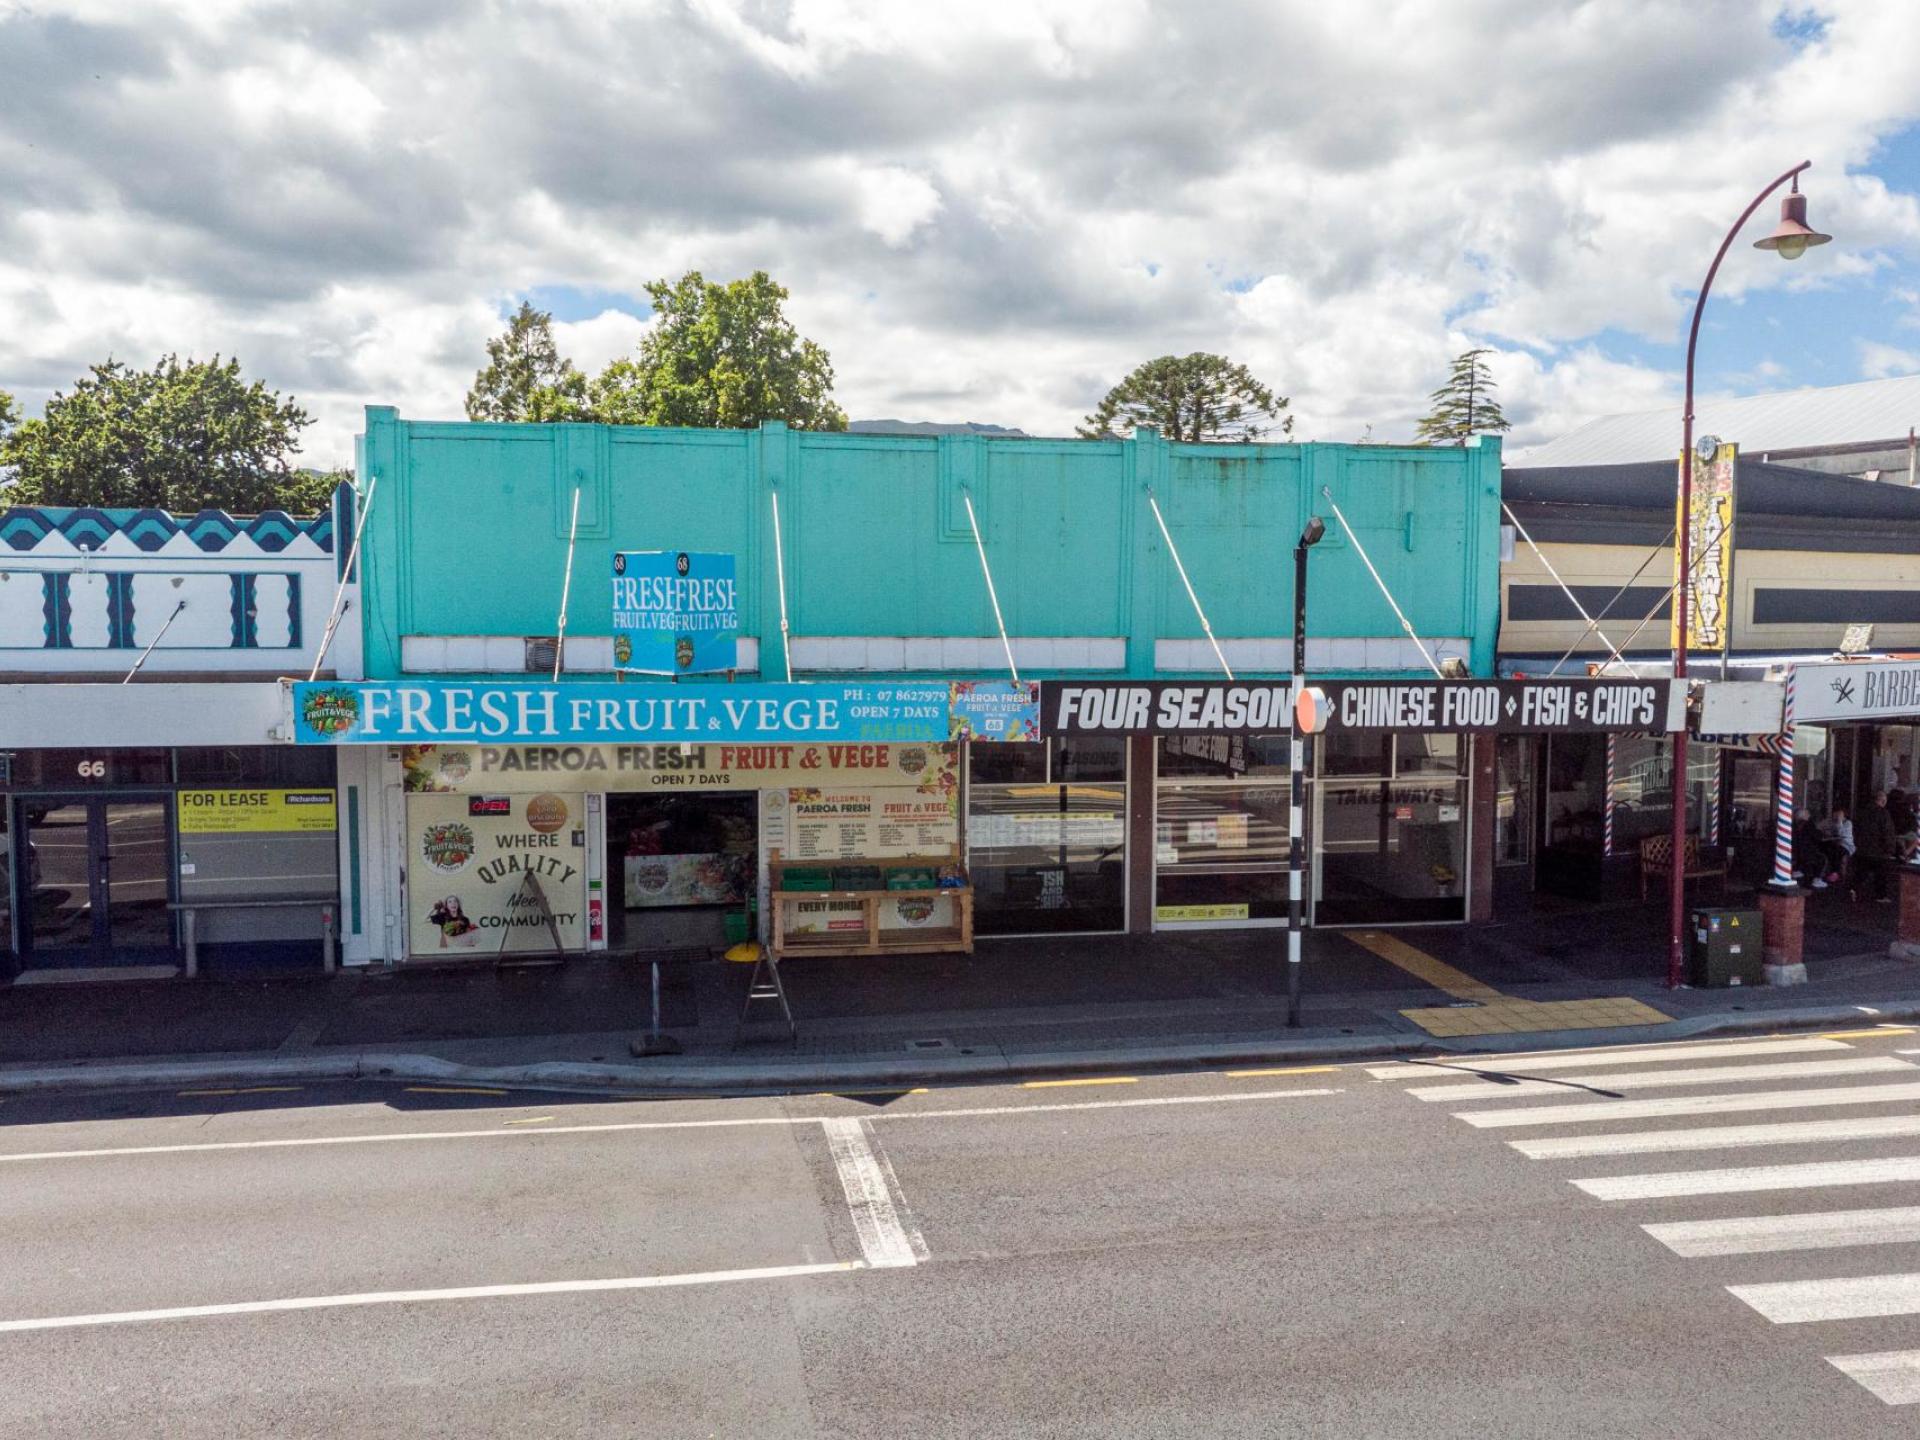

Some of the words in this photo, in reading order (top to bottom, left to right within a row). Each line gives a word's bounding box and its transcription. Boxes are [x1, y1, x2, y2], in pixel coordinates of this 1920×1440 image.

[615, 557, 625, 570] 68
[677, 557, 688, 570] 68
[877, 690, 892, 701] 07
[896, 690, 946, 702] 8627979
[957, 693, 998, 702] PAEROA
[1001, 693, 1031, 702] FRESH
[359, 688, 559, 736] FRESH
[569, 699, 705, 731] FRUIT
[708, 716, 721, 730] &
[721, 699, 840, 730] VEGE
[850, 706, 889, 718] OPEN
[893, 708, 900, 718] 7
[904, 706, 939, 718] DAYS
[967, 703, 988, 712] FRUIT
[1001, 703, 1022, 712] VEGE
[1057, 688, 1151, 729] FOUR
[1157, 688, 1292, 729] SEASON
[1341, 686, 1437, 727] CHINESE
[1442, 686, 1500, 727] FOOD
[1521, 686, 1571, 726] FISH
[1575, 691, 1588, 719] &
[1592, 686, 1656, 726] CHIPS
[481, 747, 607, 772] PAEROA
[617, 745, 706, 770] FRESH
[720, 746, 794, 770] FRUIT
[800, 746, 821, 769] &
[827, 745, 889, 768] VEGE
[77, 761, 105, 777] 66
[651, 775, 684, 785] OPEN
[688, 774, 695, 784] 7
[699, 774, 730, 784] DAYS
[183, 794, 215, 806] FOR
[220, 793, 268, 806] LEASE
[797, 804, 838, 813] PAEROA
[841, 803, 871, 812] FRESH
[885, 804, 912, 813] FRUIT
[925, 803, 947, 811] VEGE
[496, 834, 559, 848] WHERE
[477, 854, 576, 884] QUALITY
[506, 893, 547, 908] Mee
[798, 902, 827, 912] EVERY
[828, 900, 864, 911] MONDA
